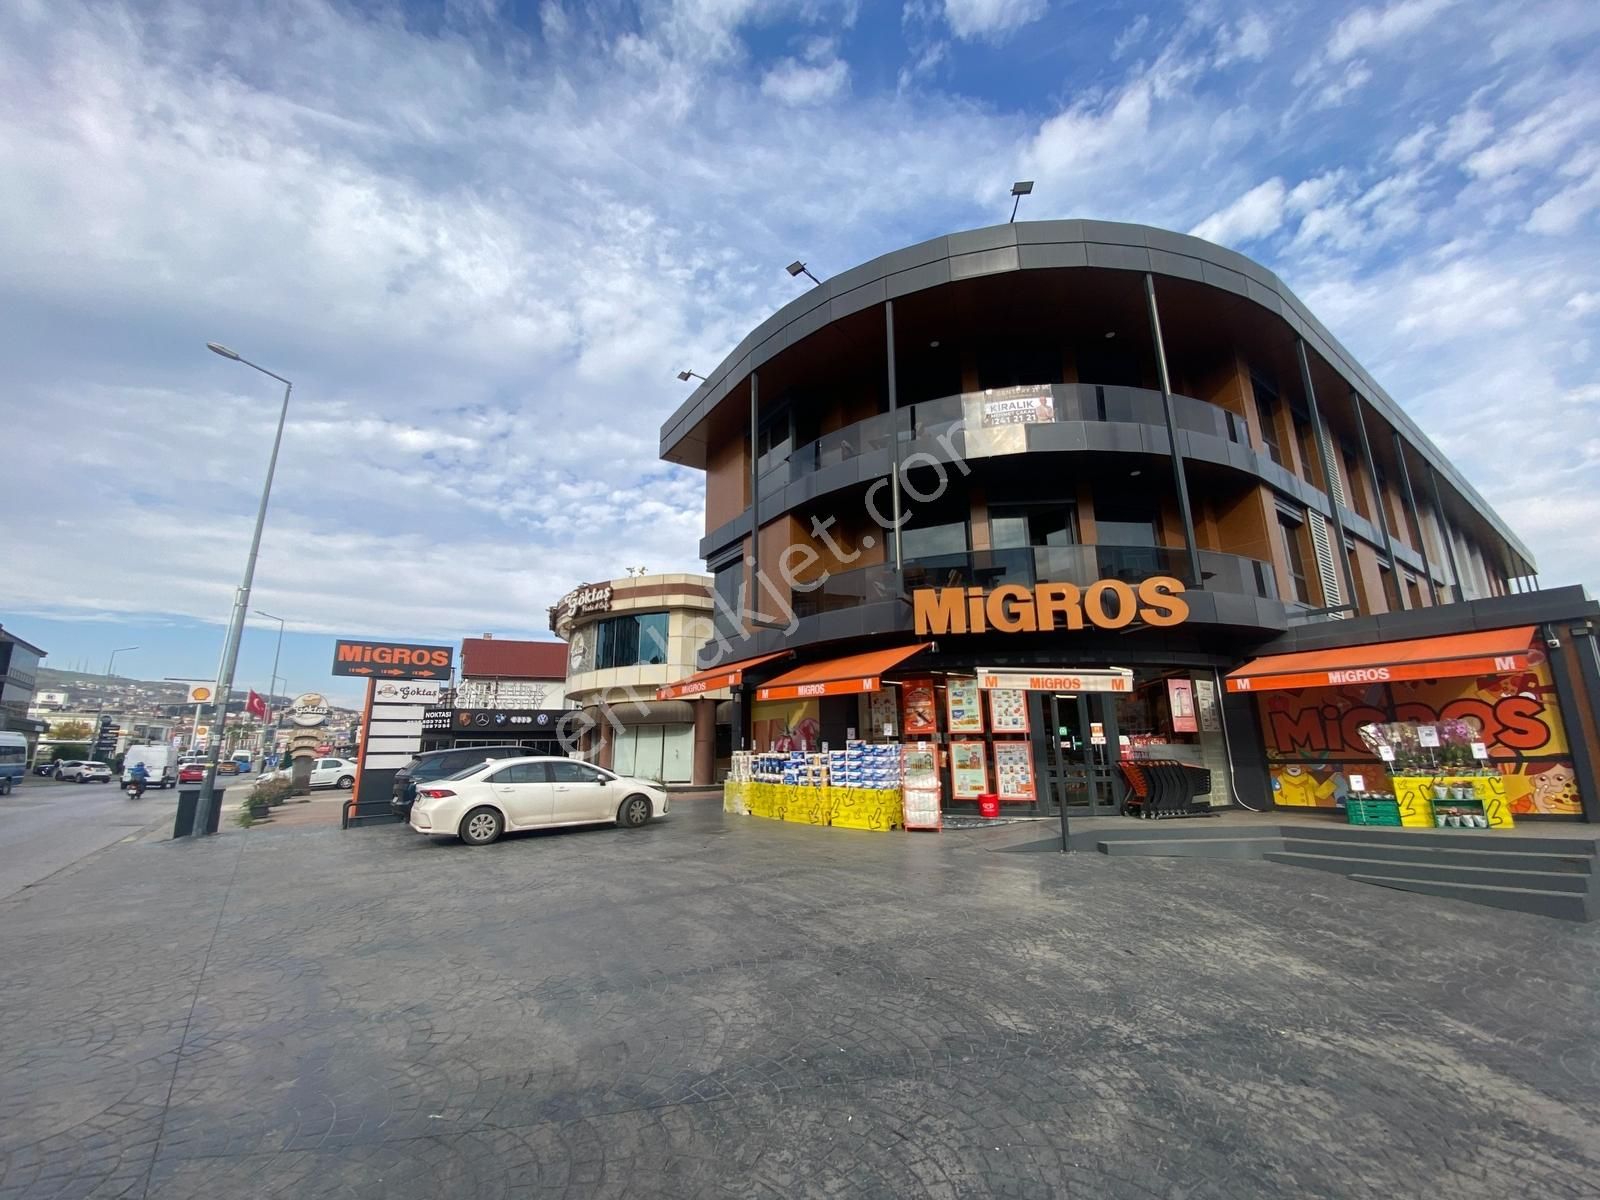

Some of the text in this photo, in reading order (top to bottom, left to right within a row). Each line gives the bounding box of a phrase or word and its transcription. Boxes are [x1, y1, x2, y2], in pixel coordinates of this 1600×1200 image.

[913, 576, 1190, 635] MiGROS
[338, 645, 449, 667] MiGROS
[728, 674, 735, 684] M
[985, 676, 998, 688] M
[1030, 677, 1081, 689] MiGROS
[1111, 678, 1125, 690] M
[1236, 656, 1516, 690] M MiGROS M
[762, 688, 769, 699] M
[863, 679, 873, 690] M
